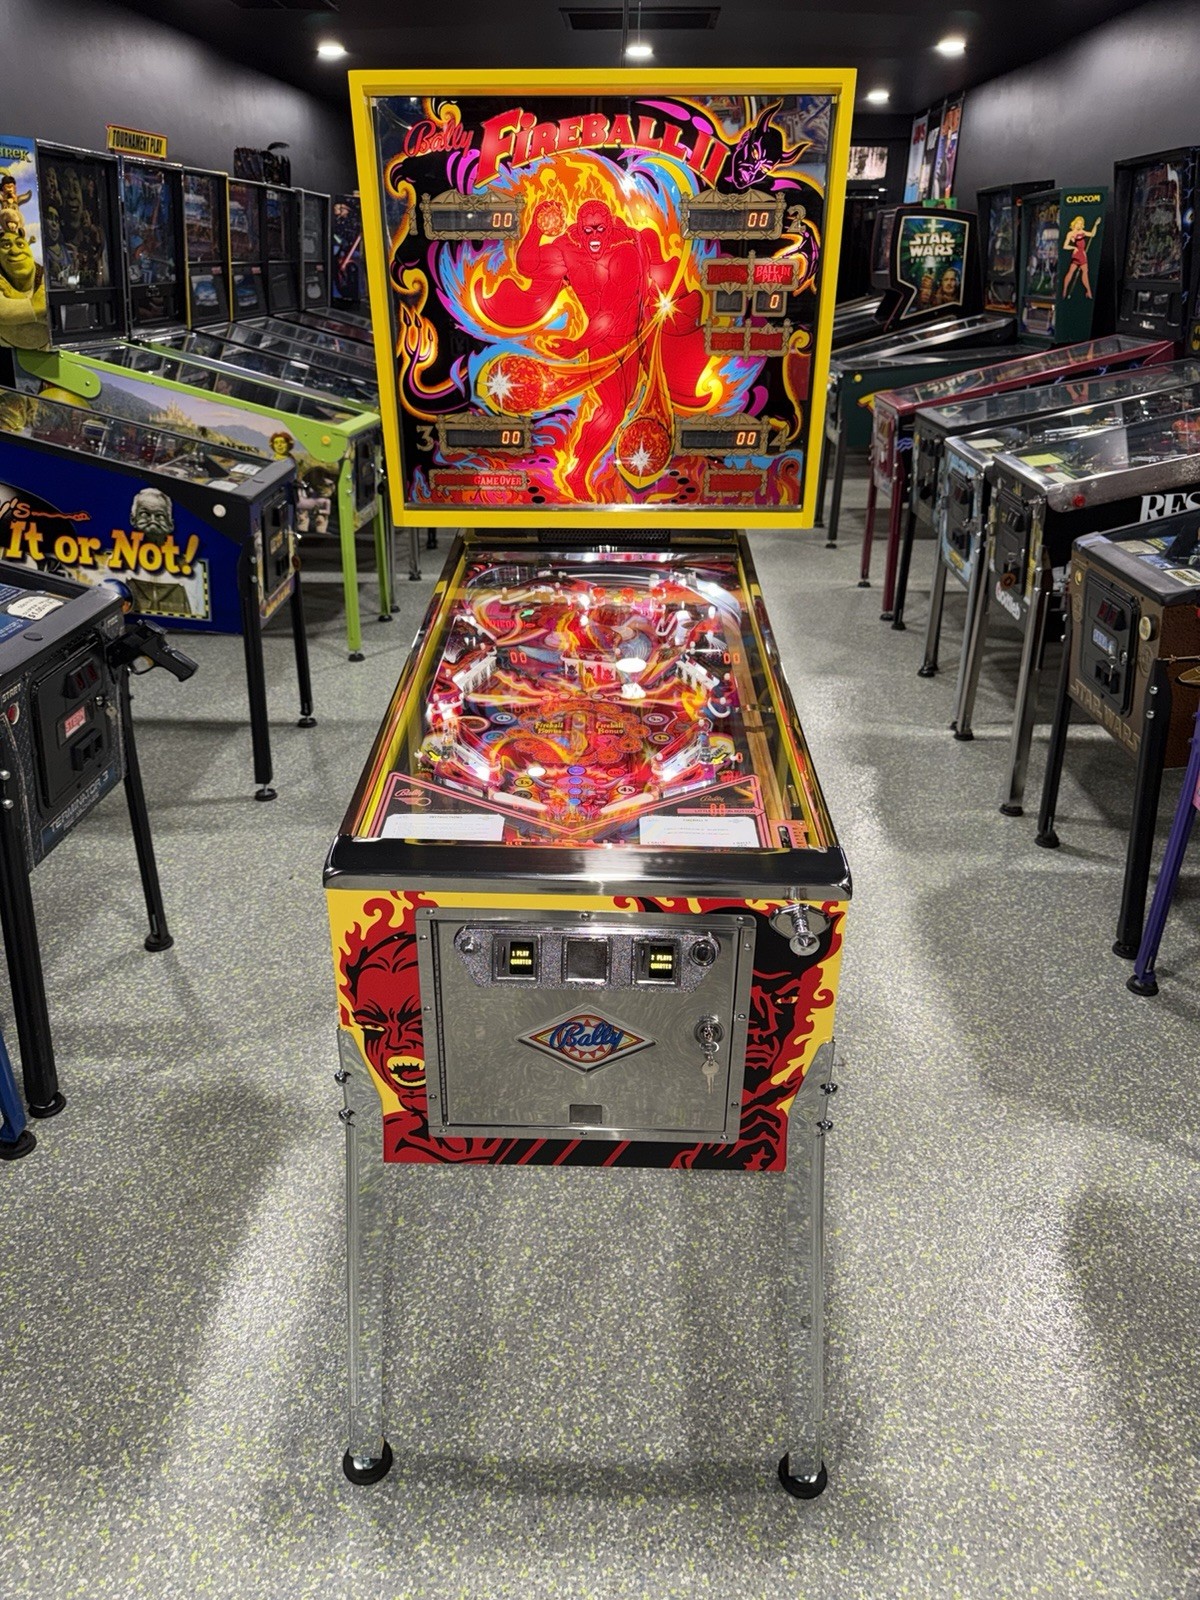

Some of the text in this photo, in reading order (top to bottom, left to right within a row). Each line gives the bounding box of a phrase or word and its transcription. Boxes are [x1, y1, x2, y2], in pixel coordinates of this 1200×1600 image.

[112, 129, 164, 154] TOURNAMENT PLAY
[404, 117, 474, 158] Bally
[687, 130, 732, 190] II
[1066, 194, 1101, 204] CAPCOM
[492, 212, 513, 228] 00
[747, 212, 769, 227] 00
[909, 231, 955, 245] STAR
[909, 244, 955, 257] WARS
[756, 265, 779, 277] BALL
[781, 265, 792, 277] IN
[762, 274, 783, 282] PLAY
[769, 294, 780, 309] 0
[416, 425, 435, 452] 3
[501, 431, 521, 445] 00
[736, 431, 757, 446] 00
[473, 475, 499, 486] GAME
[500, 475, 521, 486] OVER
[5, 521, 200, 576] It or Not!
[1, 682, 22, 703] START
[1070, 678, 1142, 753] STAR WARS
[535, 721, 564, 729] Fireball
[595, 721, 624, 729] Fireball
[394, 788, 425, 797] Bally
[50, 769, 109, 833] TERMINATOR 3
[549, 1021, 624, 1050] Bally
